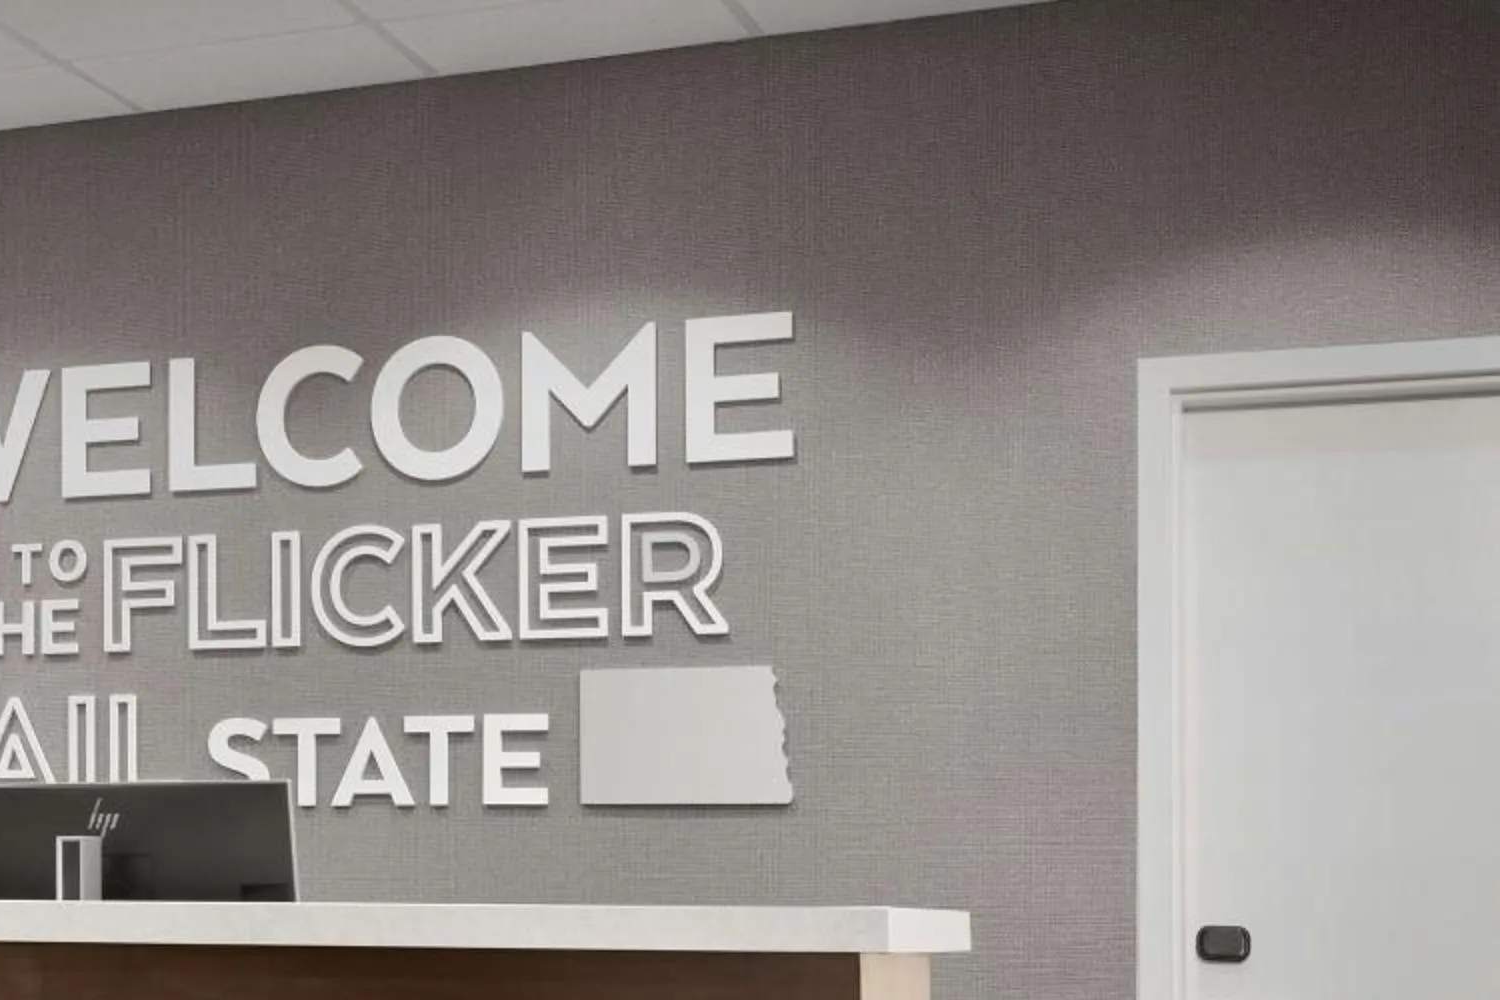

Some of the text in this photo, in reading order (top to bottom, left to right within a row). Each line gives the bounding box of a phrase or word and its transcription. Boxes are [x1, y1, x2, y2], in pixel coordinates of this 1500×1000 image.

[12, 539, 88, 584] TO
[103, 512, 730, 653] FLICKER
[207, 713, 550, 807] STATE
